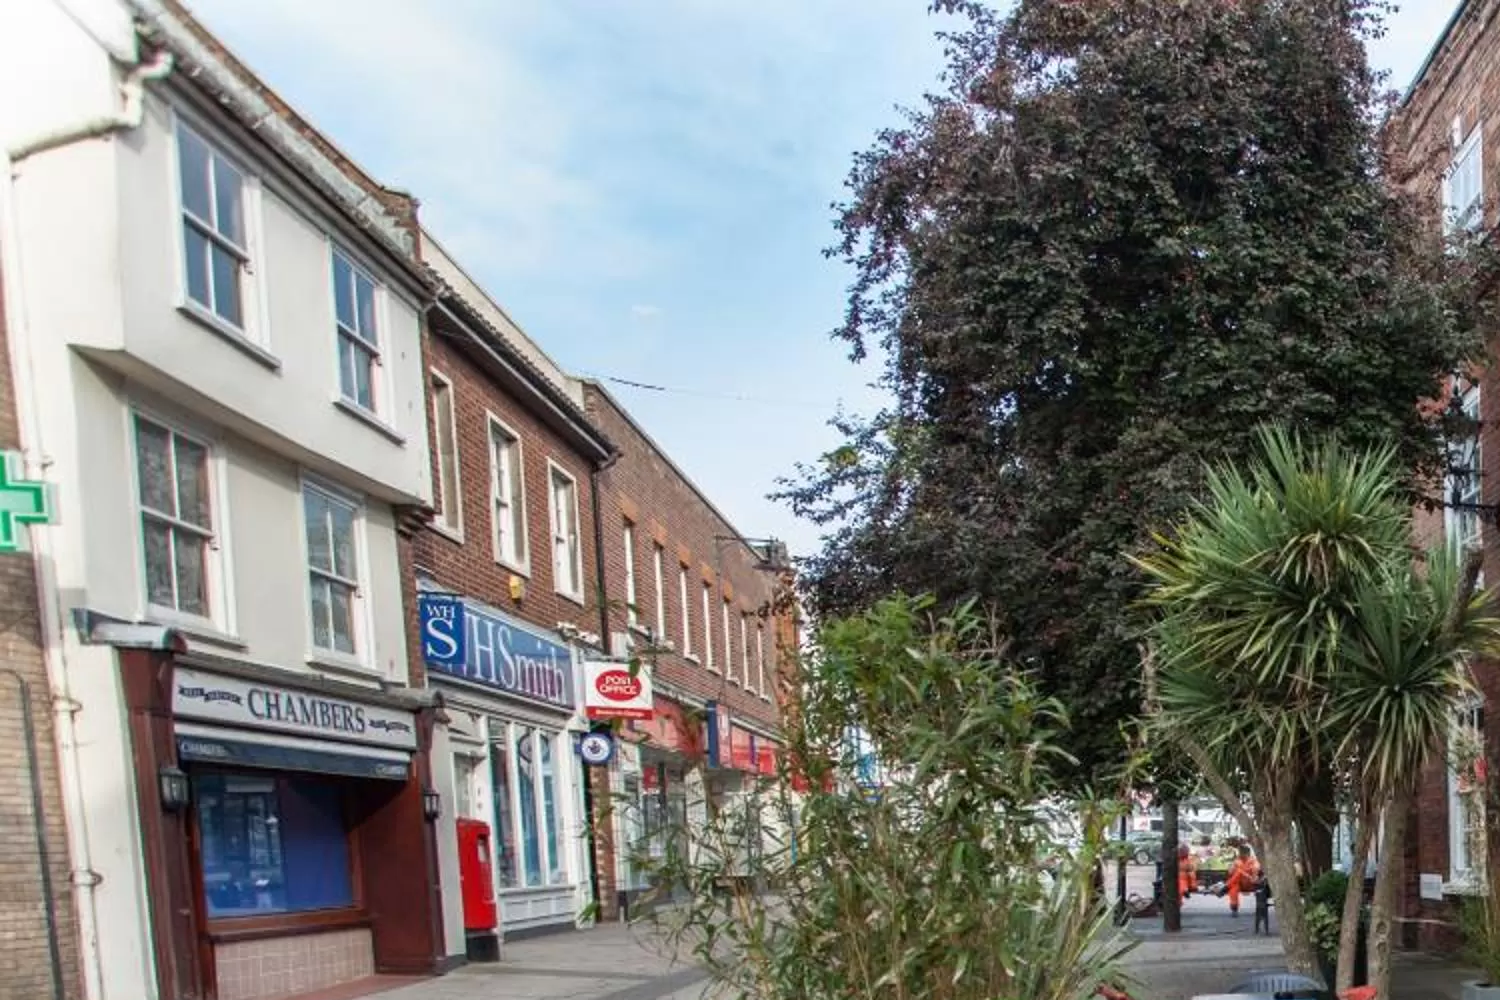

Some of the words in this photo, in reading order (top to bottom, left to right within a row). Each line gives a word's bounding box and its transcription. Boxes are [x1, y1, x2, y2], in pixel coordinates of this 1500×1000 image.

[426, 604, 456, 619] WH
[426, 617, 458, 659] S
[599, 684, 638, 695] OFFICE
[247, 687, 366, 734] CHAMBERS
